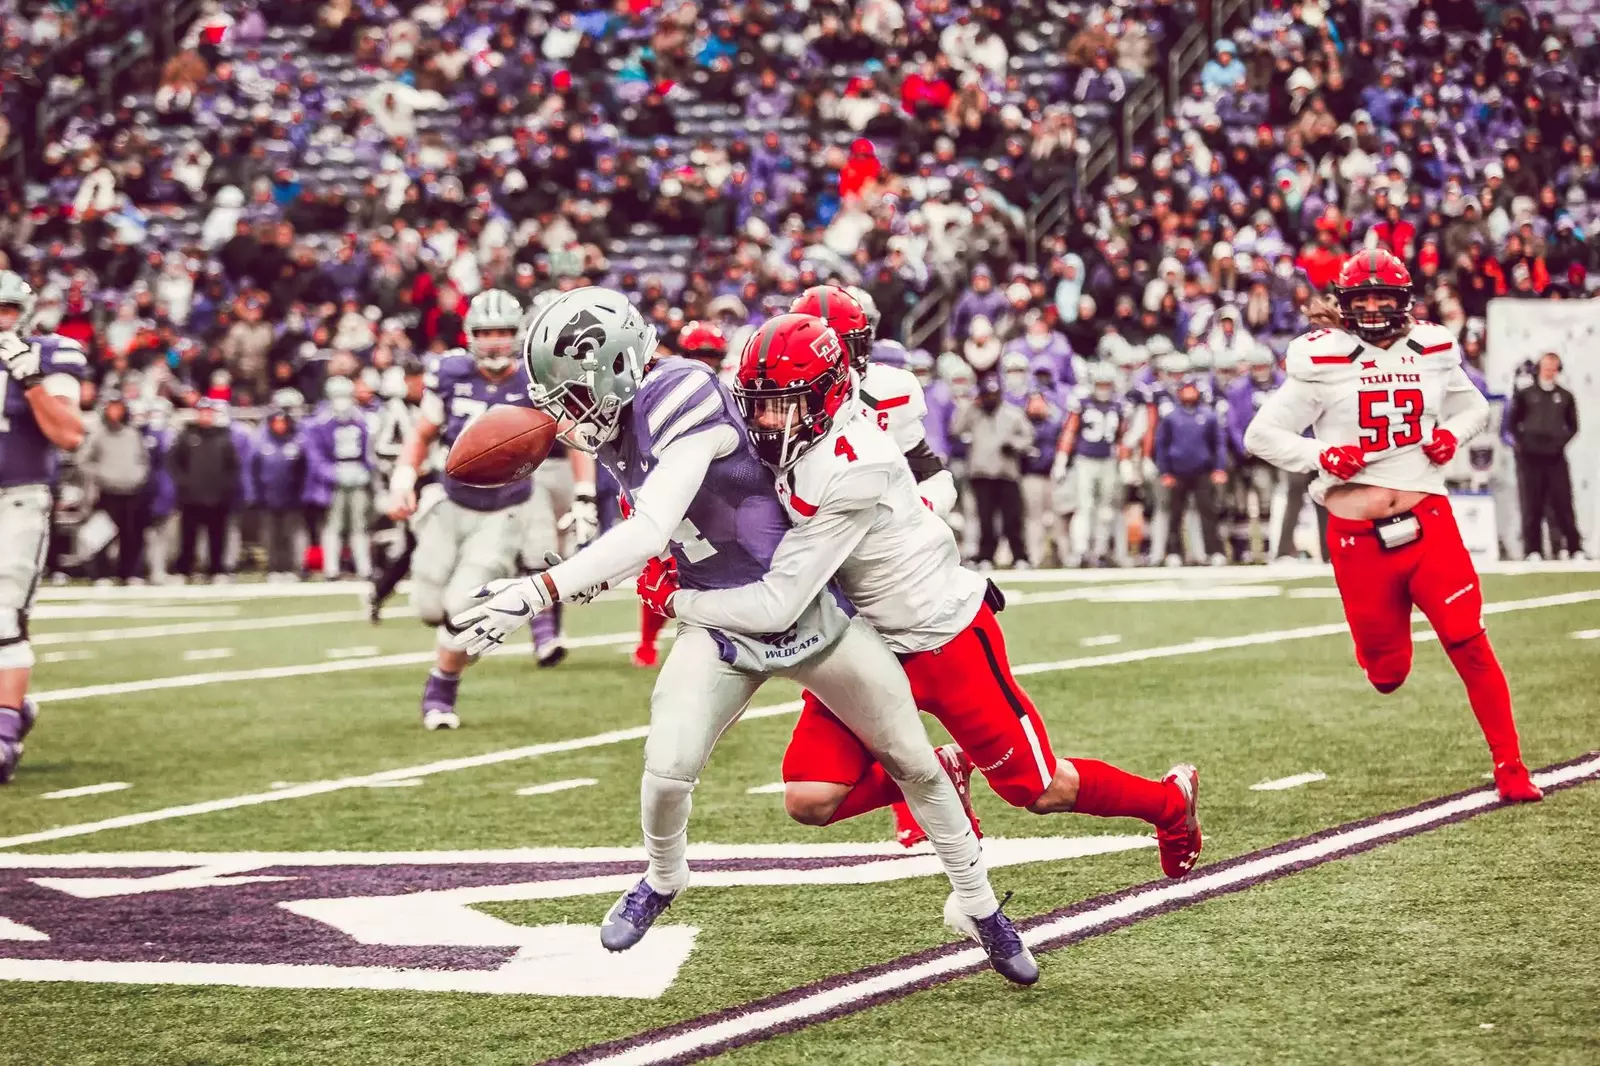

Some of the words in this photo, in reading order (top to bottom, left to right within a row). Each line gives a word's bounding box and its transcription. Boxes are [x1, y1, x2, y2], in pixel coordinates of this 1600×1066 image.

[1360, 374, 1392, 384] TEXAS
[1395, 374, 1420, 382] TECH
[1358, 389, 1424, 453] 53
[834, 435, 858, 463] 4
[765, 633, 819, 659] WILDCATS
